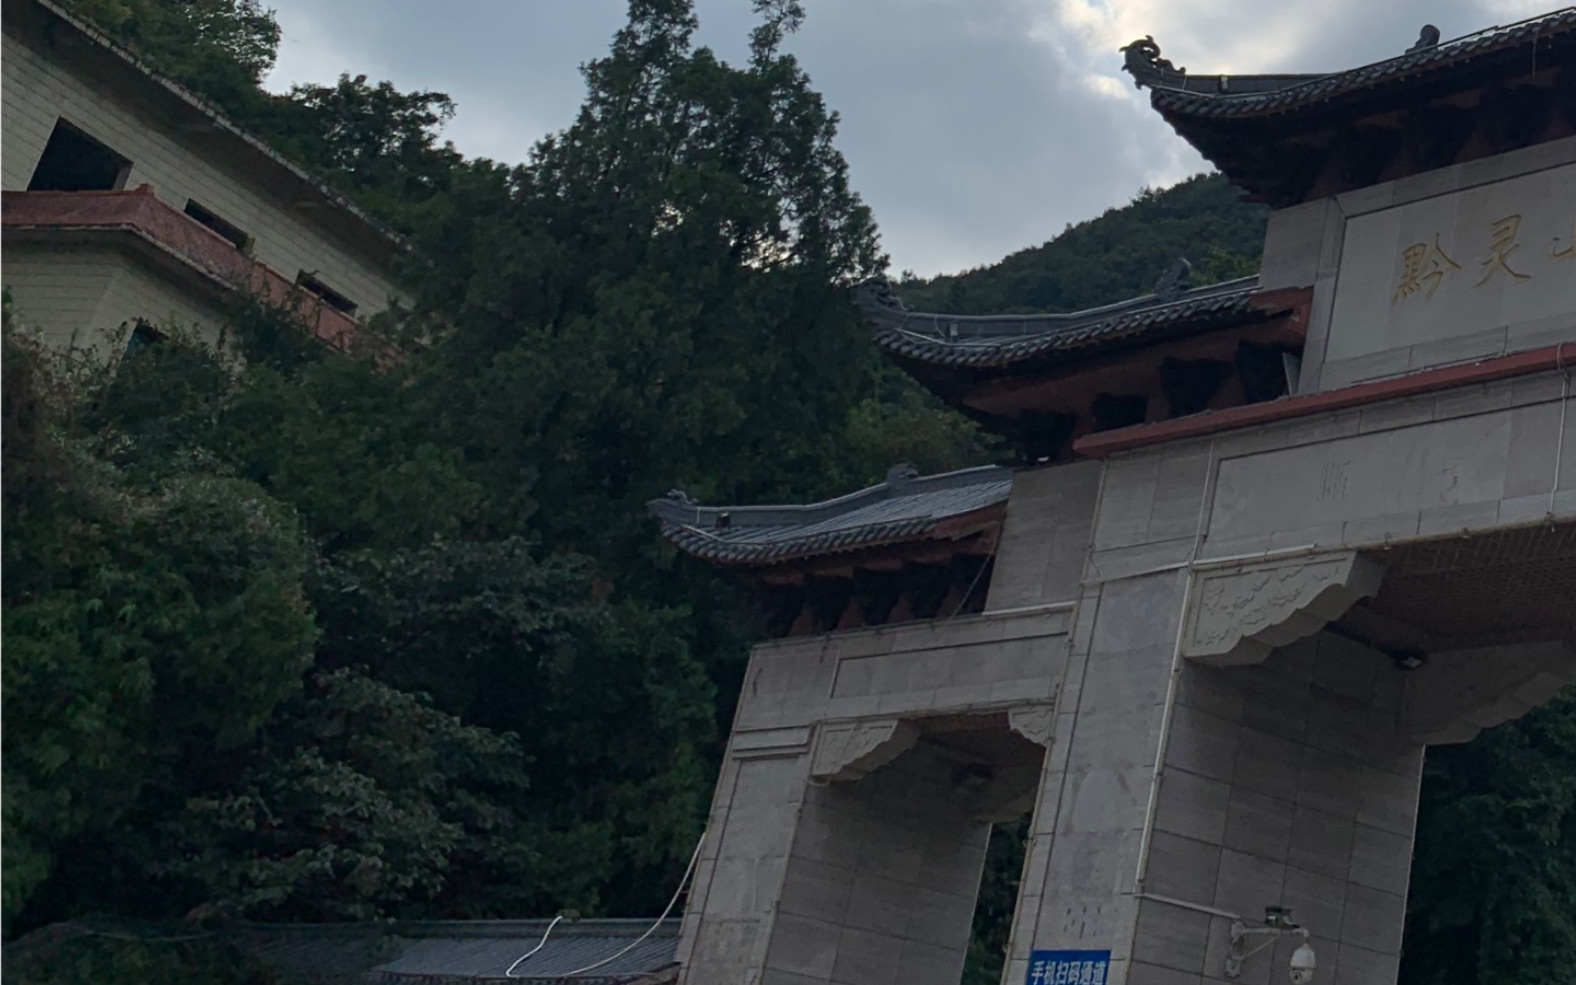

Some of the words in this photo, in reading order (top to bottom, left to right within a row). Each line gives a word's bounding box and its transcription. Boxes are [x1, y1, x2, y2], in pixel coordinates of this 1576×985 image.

[1031, 960, 1107, 985] 手机扫码通道
